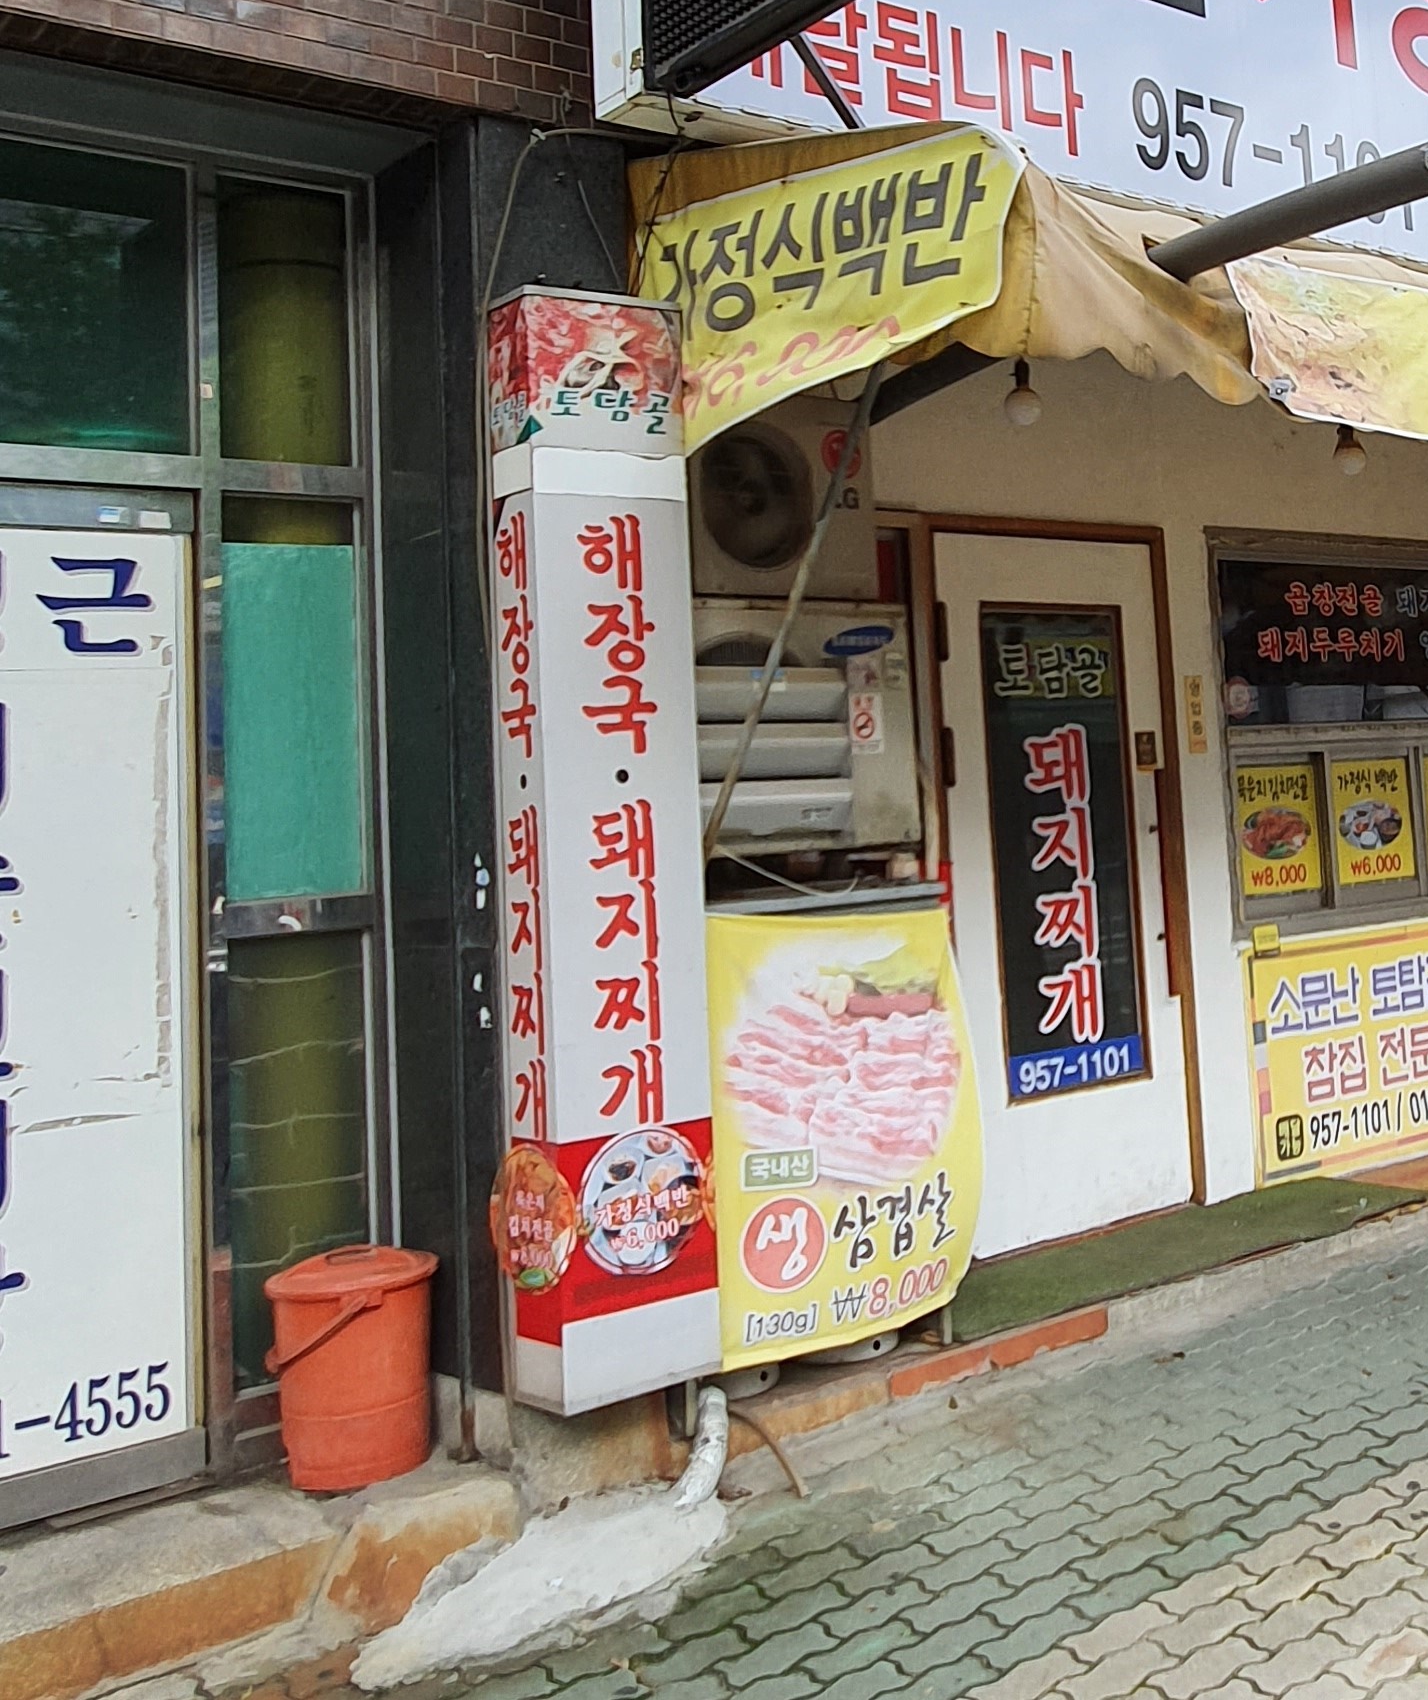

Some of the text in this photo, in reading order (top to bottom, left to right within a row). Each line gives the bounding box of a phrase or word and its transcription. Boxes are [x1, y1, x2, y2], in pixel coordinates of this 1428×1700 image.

[551, 388, 671, 436] 토담골
[36, 556, 152, 654] 근
[1284, 582, 1384, 618] 곱창전골
[994, 642, 1109, 700] 토담골
[1256, 627, 1406, 662] 돼지두루치기
[497, 510, 546, 1142] 해장국 돼지찌개
[576, 512, 665, 1126] 해장국 돼지찌개
[1026, 721, 1104, 1045] 돼지찌개
[1270, 965, 1360, 1035] 소문난
[1018, 1045, 1132, 1095] 957-1101
[1303, 1035, 1367, 1104] 참집
[747, 1155, 810, 1183] 국내산
[595, 1183, 690, 1228] 가정식백반
[755, 1169, 956, 1284] 생 삼겹살
[0, 1361, 170, 1459] -4555
